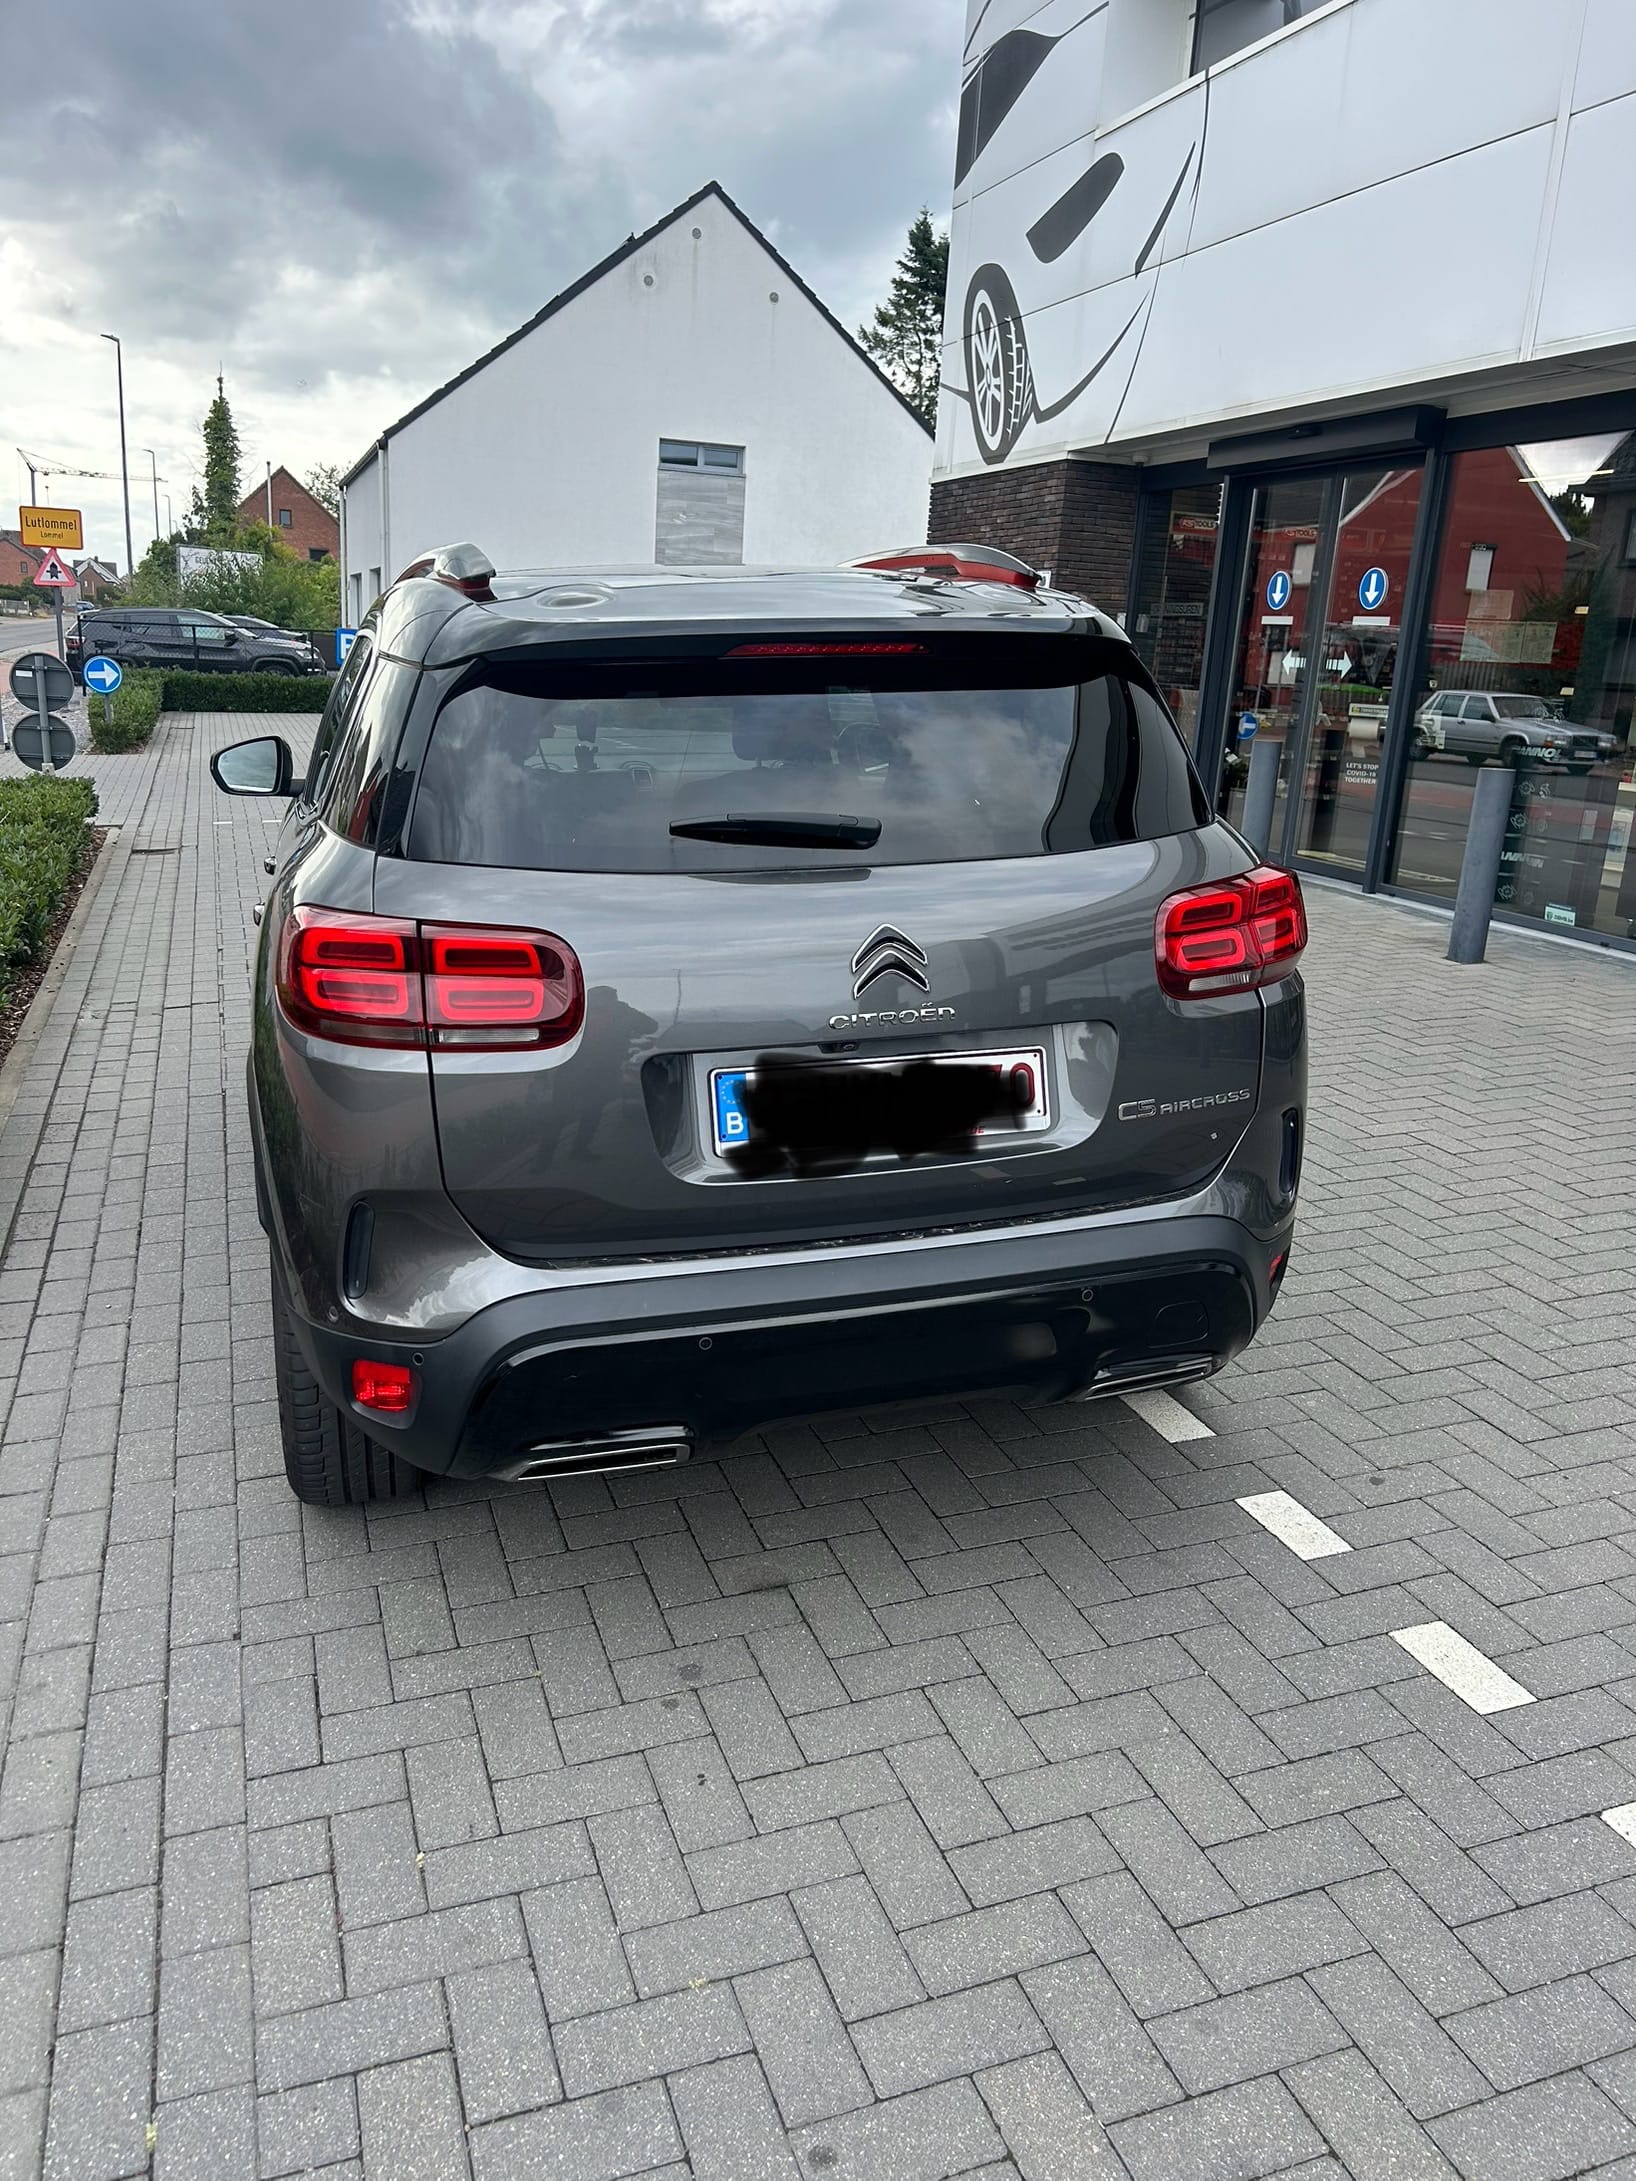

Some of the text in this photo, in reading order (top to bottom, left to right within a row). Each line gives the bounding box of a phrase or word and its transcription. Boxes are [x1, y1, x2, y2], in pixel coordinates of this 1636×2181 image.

[25, 515, 77, 530] Lutlommel
[40, 530, 64, 540] Lommel
[1345, 761, 1362, 770] LET'S
[1344, 776, 1377, 785] TOGETHER
[828, 1002, 956, 1030] CITROËN
[1118, 1088, 1251, 1121] C5 AIRCROSS
[725, 1111, 745, 1135] B
